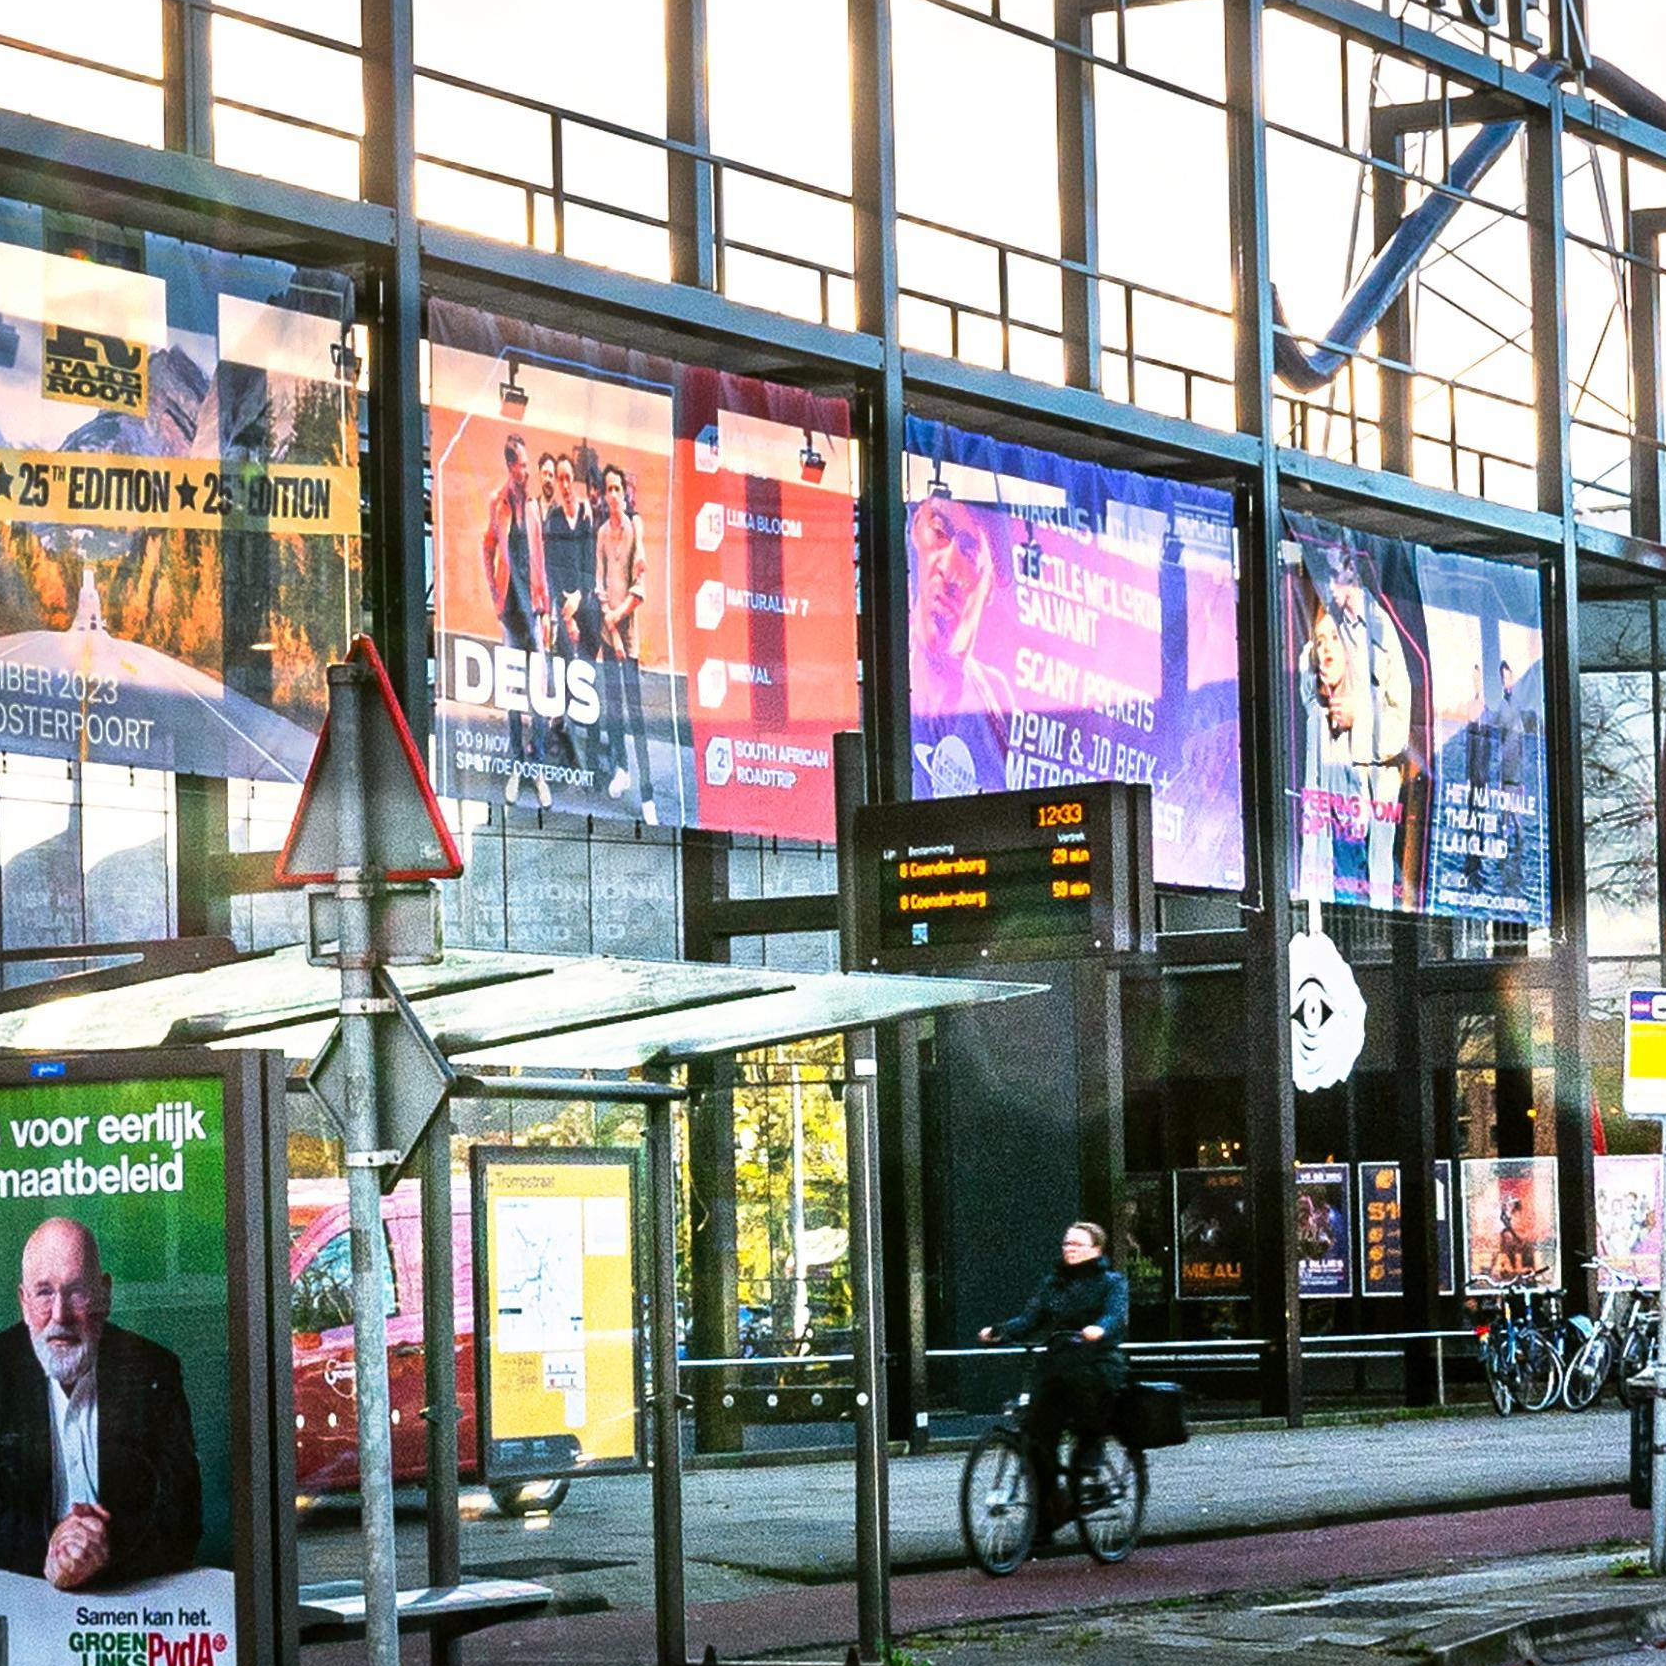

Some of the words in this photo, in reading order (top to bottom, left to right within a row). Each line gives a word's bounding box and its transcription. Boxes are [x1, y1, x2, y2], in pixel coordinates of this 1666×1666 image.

[46, 357, 141, 384] TAKE
[46, 374, 142, 407] ROOT
[19, 462, 65, 507] 25TH
[68, 466, 170, 513] EDITION
[249, 475, 331, 519] EDITION
[726, 509, 755, 530] LUKA
[757, 516, 802, 538] BLOOM
[726, 588, 797, 614] NATURALLY
[800, 600, 809, 617] 7
[1016, 586, 1099, 649] SALVANT
[58, 669, 119, 704] 2023
[454, 638, 600, 725] DEUS
[1016, 648, 1079, 704] SCARY
[1083, 669, 1155, 733] POCKETS
[456, 731, 473, 748] DO
[476, 732, 482, 748] 9
[485, 734, 510, 753] NOV
[734, 741, 775, 761] SOUTH
[779, 745, 829, 769] AFRICAN
[1010, 708, 1067, 762] DOMI
[1069, 729, 1084, 766] &
[1087, 734, 1111, 775] JD
[1115, 744, 1158, 791] BECK
[514, 760, 595, 787] OOSTERPOORT
[736, 766, 797, 789] ROADTRIP
[1005, 750, 1097, 792] METRO
[1445, 781, 1469, 804] HET
[1038, 803, 1082, 827] 12:33
[1153, 799, 1185, 844] EST
[1369, 798, 1403, 824] TOM
[910, 858, 987, 878] Coendersborg
[1070, 848, 1090, 862] min
[910, 891, 987, 910] Coendersborg
[1070, 881, 1091, 896] min
[10, 1116, 90, 1148] voor
[97, 1101, 207, 1149] eerlijk
[496, 1173, 556, 1190] Trompstraat
[76, 1606, 137, 1626] Samen
[143, 1606, 173, 1626] kan
[178, 1606, 211, 1627] het.
[69, 1632, 147, 1652] GROEN
